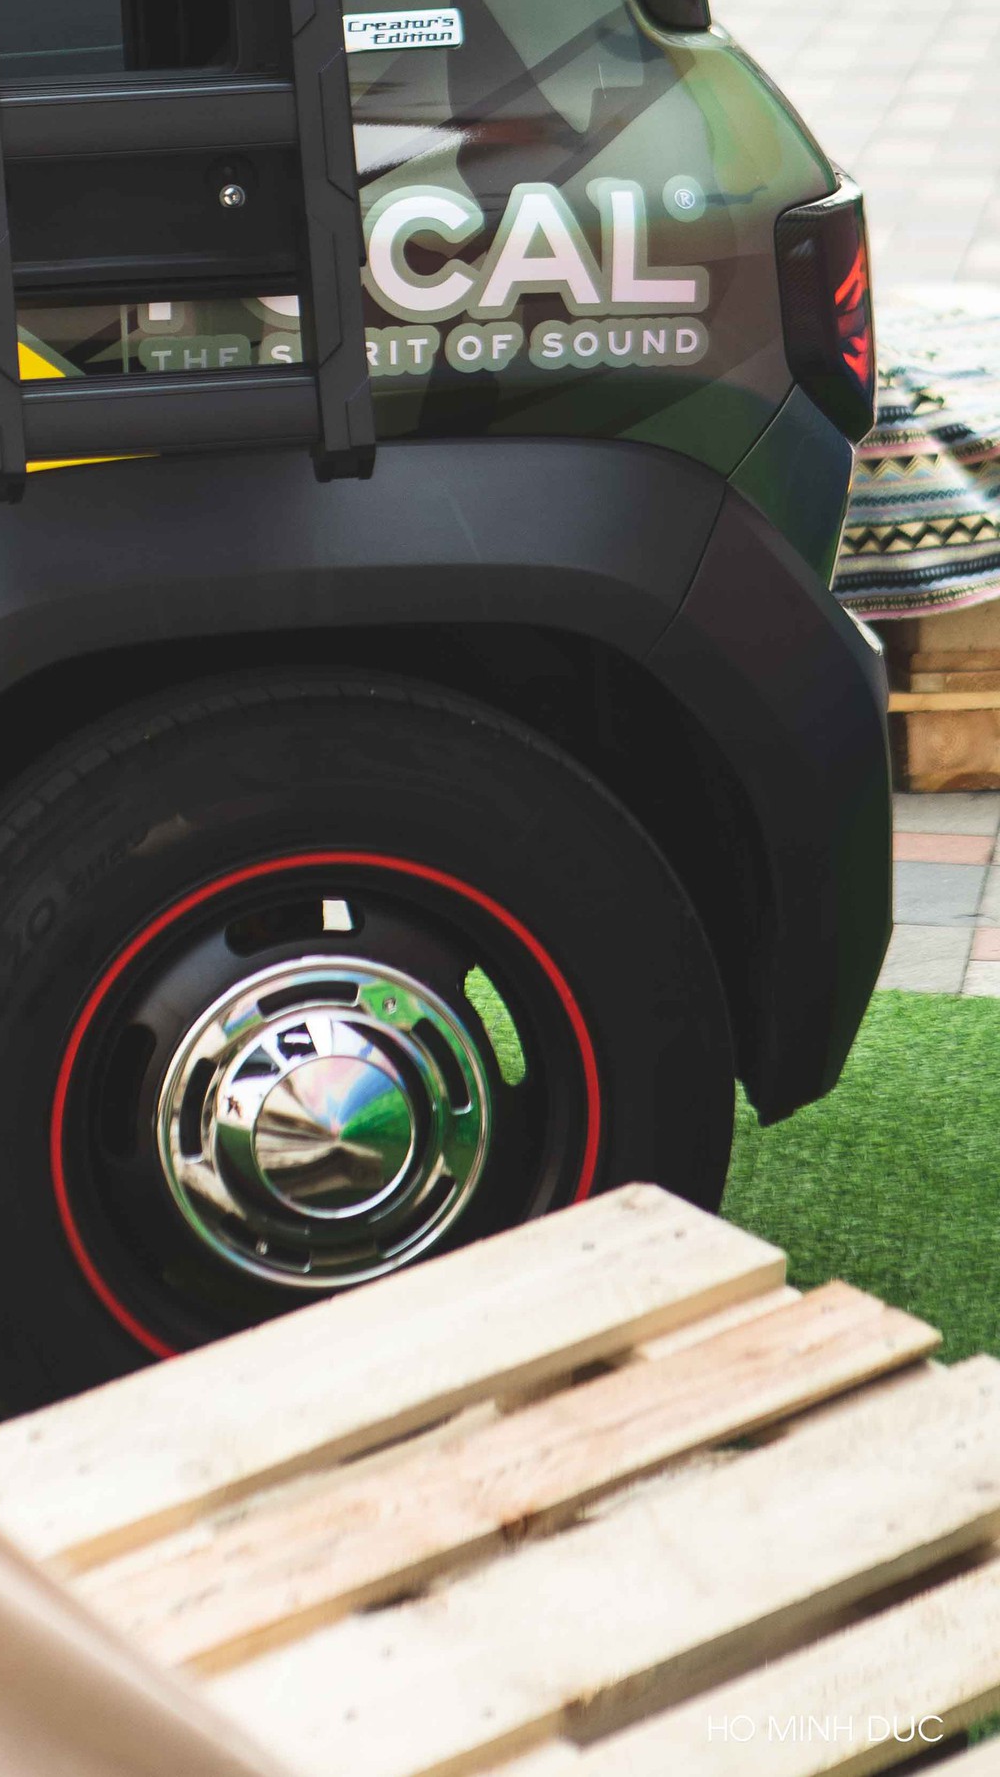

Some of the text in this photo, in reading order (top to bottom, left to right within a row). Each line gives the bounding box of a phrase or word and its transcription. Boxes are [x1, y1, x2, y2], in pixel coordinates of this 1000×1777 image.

[348, 17, 454, 33] Creator's
[370, 32, 453, 45] Edition
[271, 338, 429, 366] SRIT
[457, 334, 516, 362] OF
[542, 328, 699, 357] SOUND
